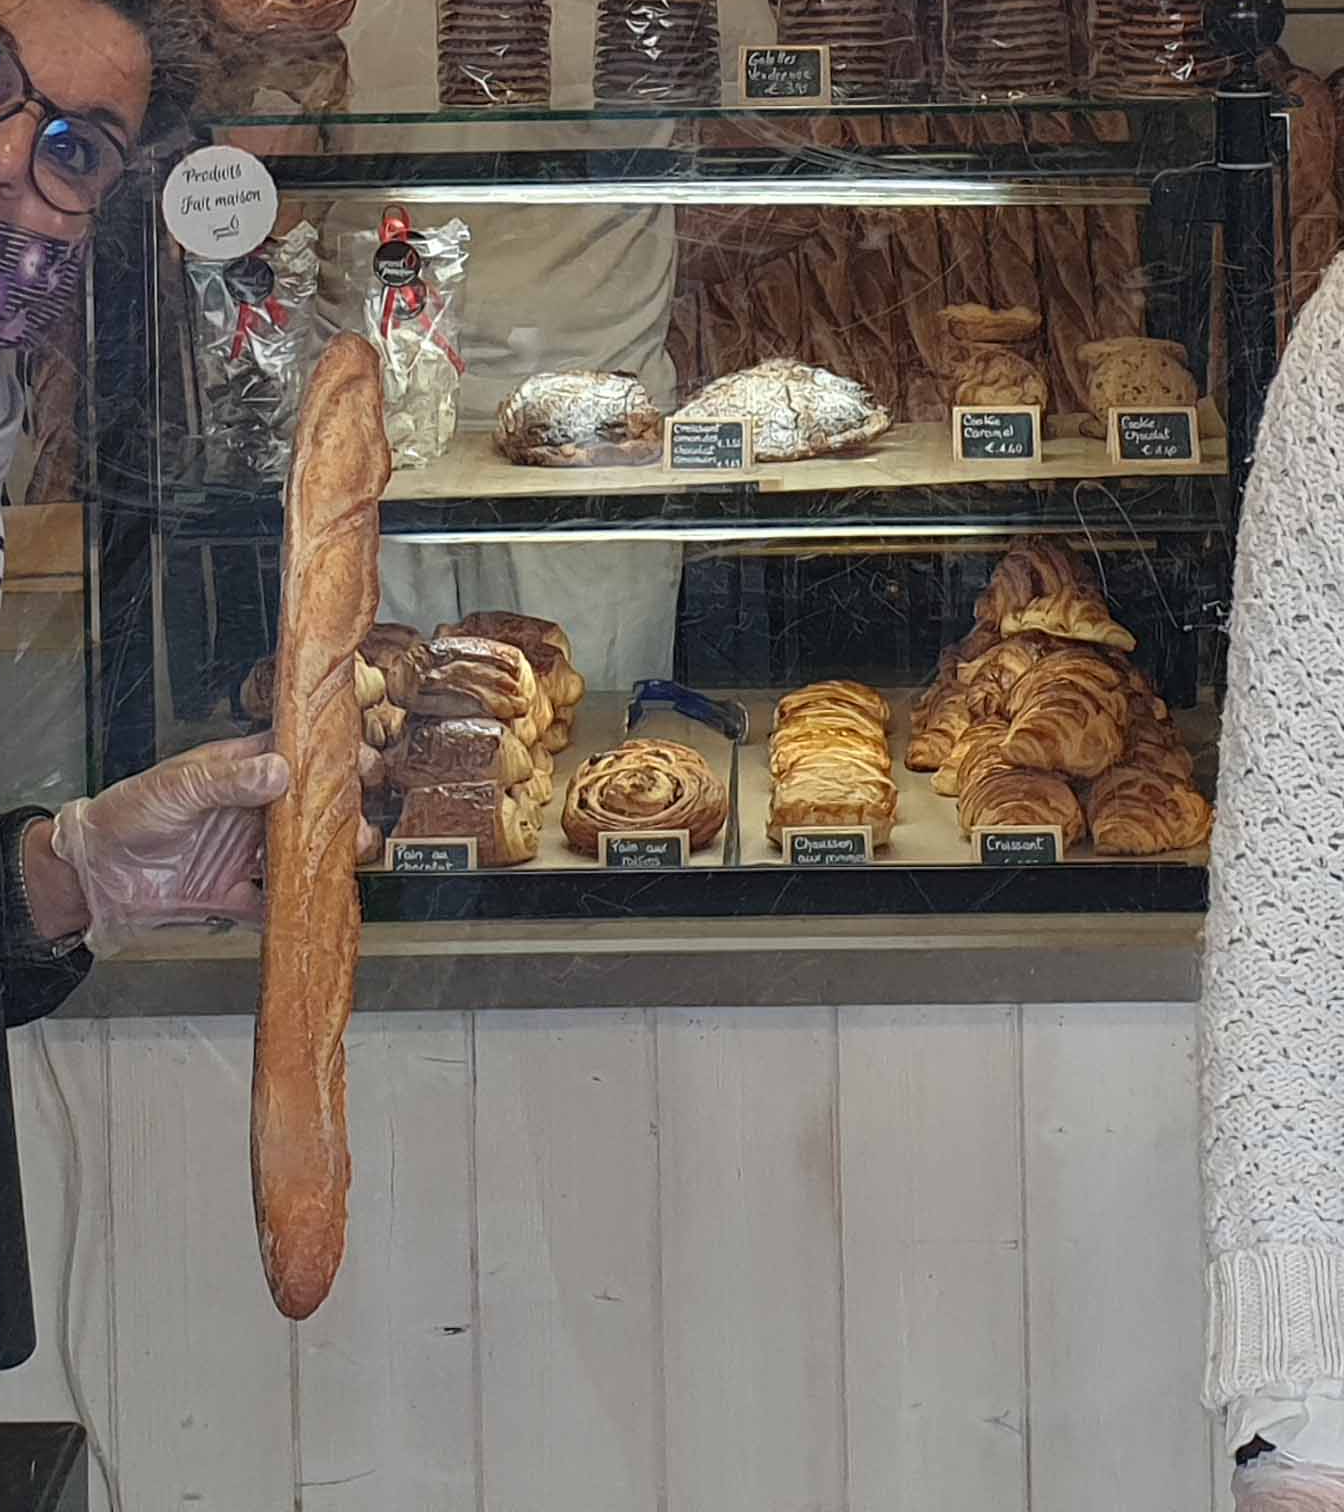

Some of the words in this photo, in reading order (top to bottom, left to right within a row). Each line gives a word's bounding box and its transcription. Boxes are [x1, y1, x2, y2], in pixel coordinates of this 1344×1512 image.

[182, 162, 242, 185] Produits
[180, 194, 211, 216] Fait
[214, 187, 262, 208] maison
[396, 845, 424, 863] Pain
[432, 850, 449, 859] au
[610, 839, 639, 854] Pain
